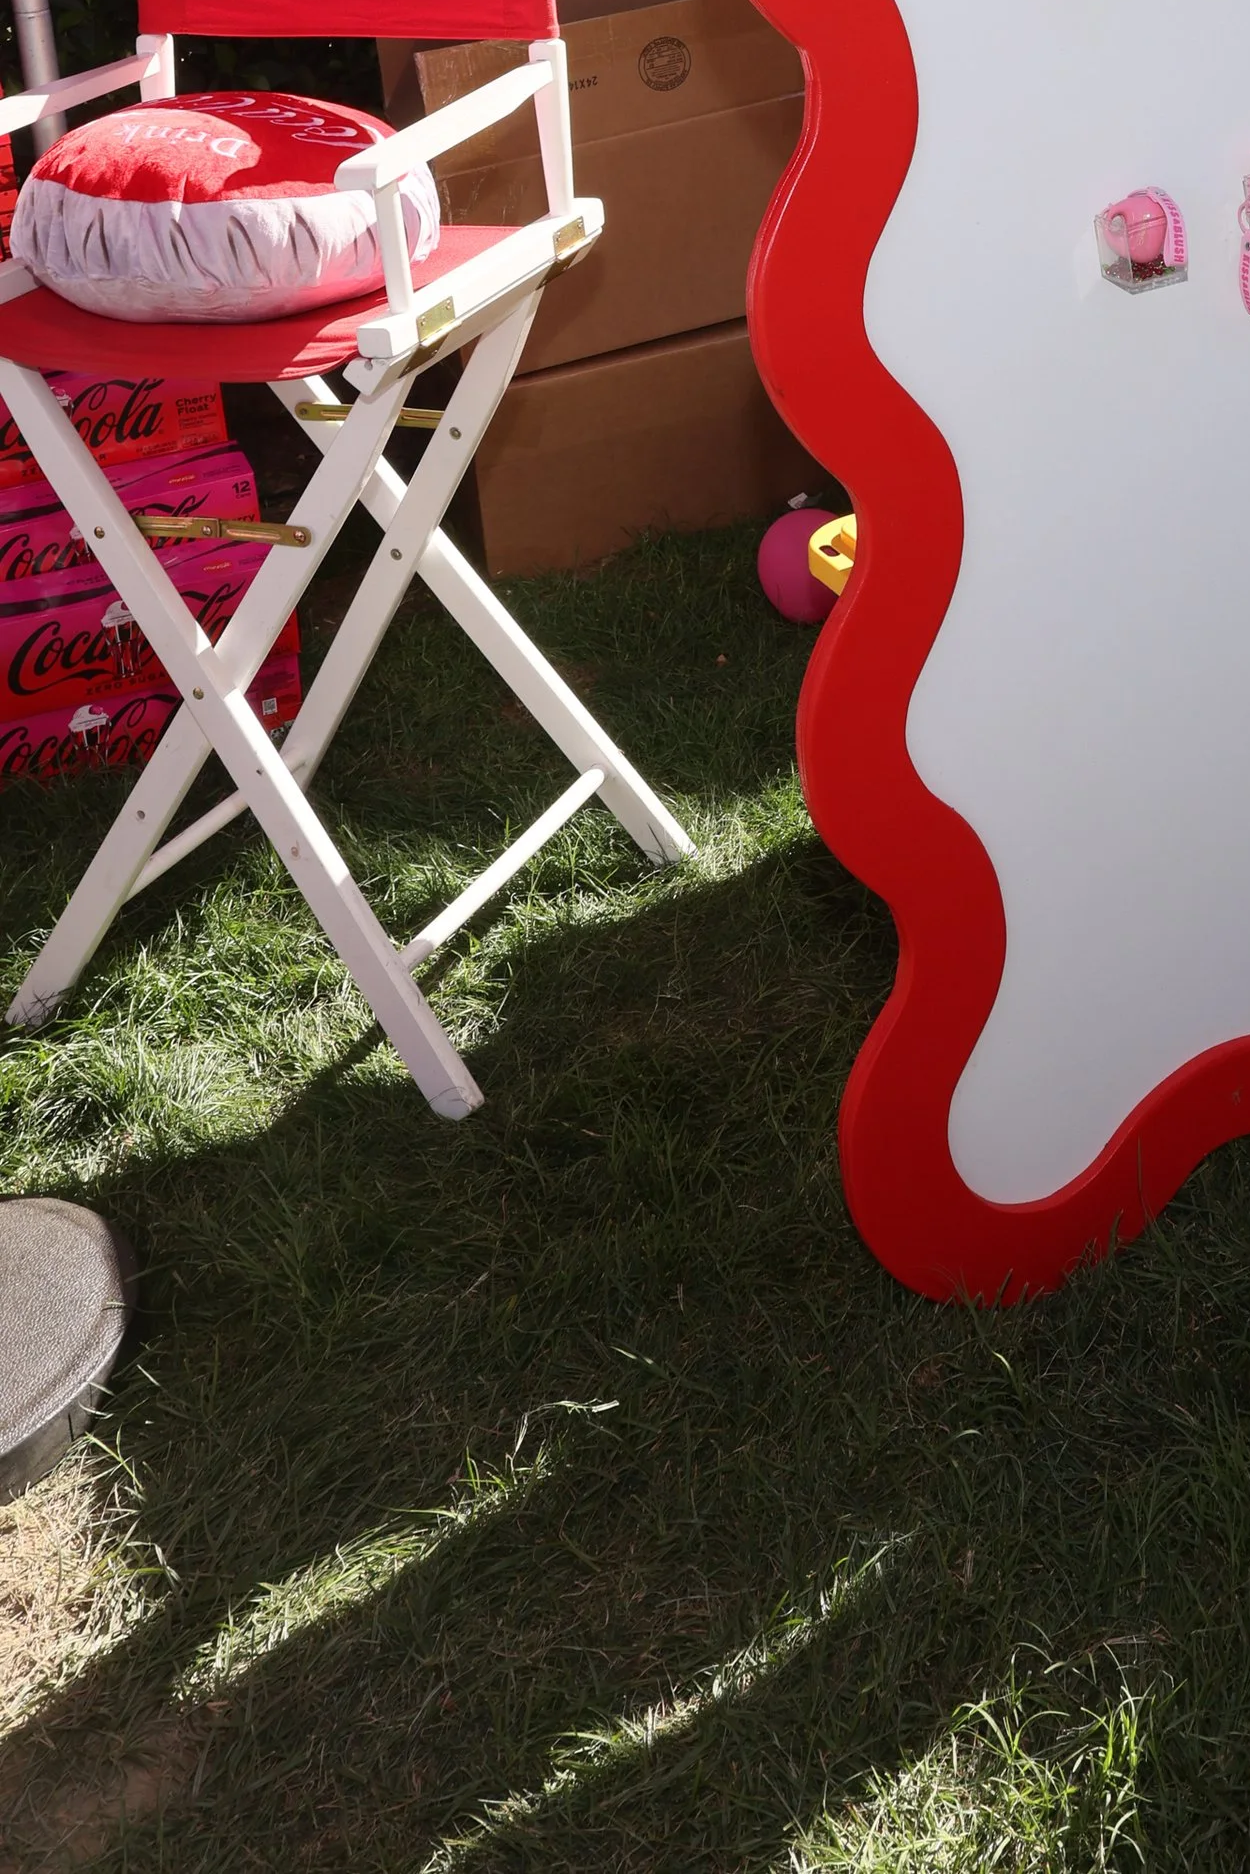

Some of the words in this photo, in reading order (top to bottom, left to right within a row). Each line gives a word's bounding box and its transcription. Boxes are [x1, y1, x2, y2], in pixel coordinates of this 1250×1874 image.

[114, 122, 251, 158] Drink
[175, 393, 217, 408] Cherry
[177, 403, 209, 416] Float
[232, 480, 251, 494] 12
[129, 672, 171, 686] SUGA
